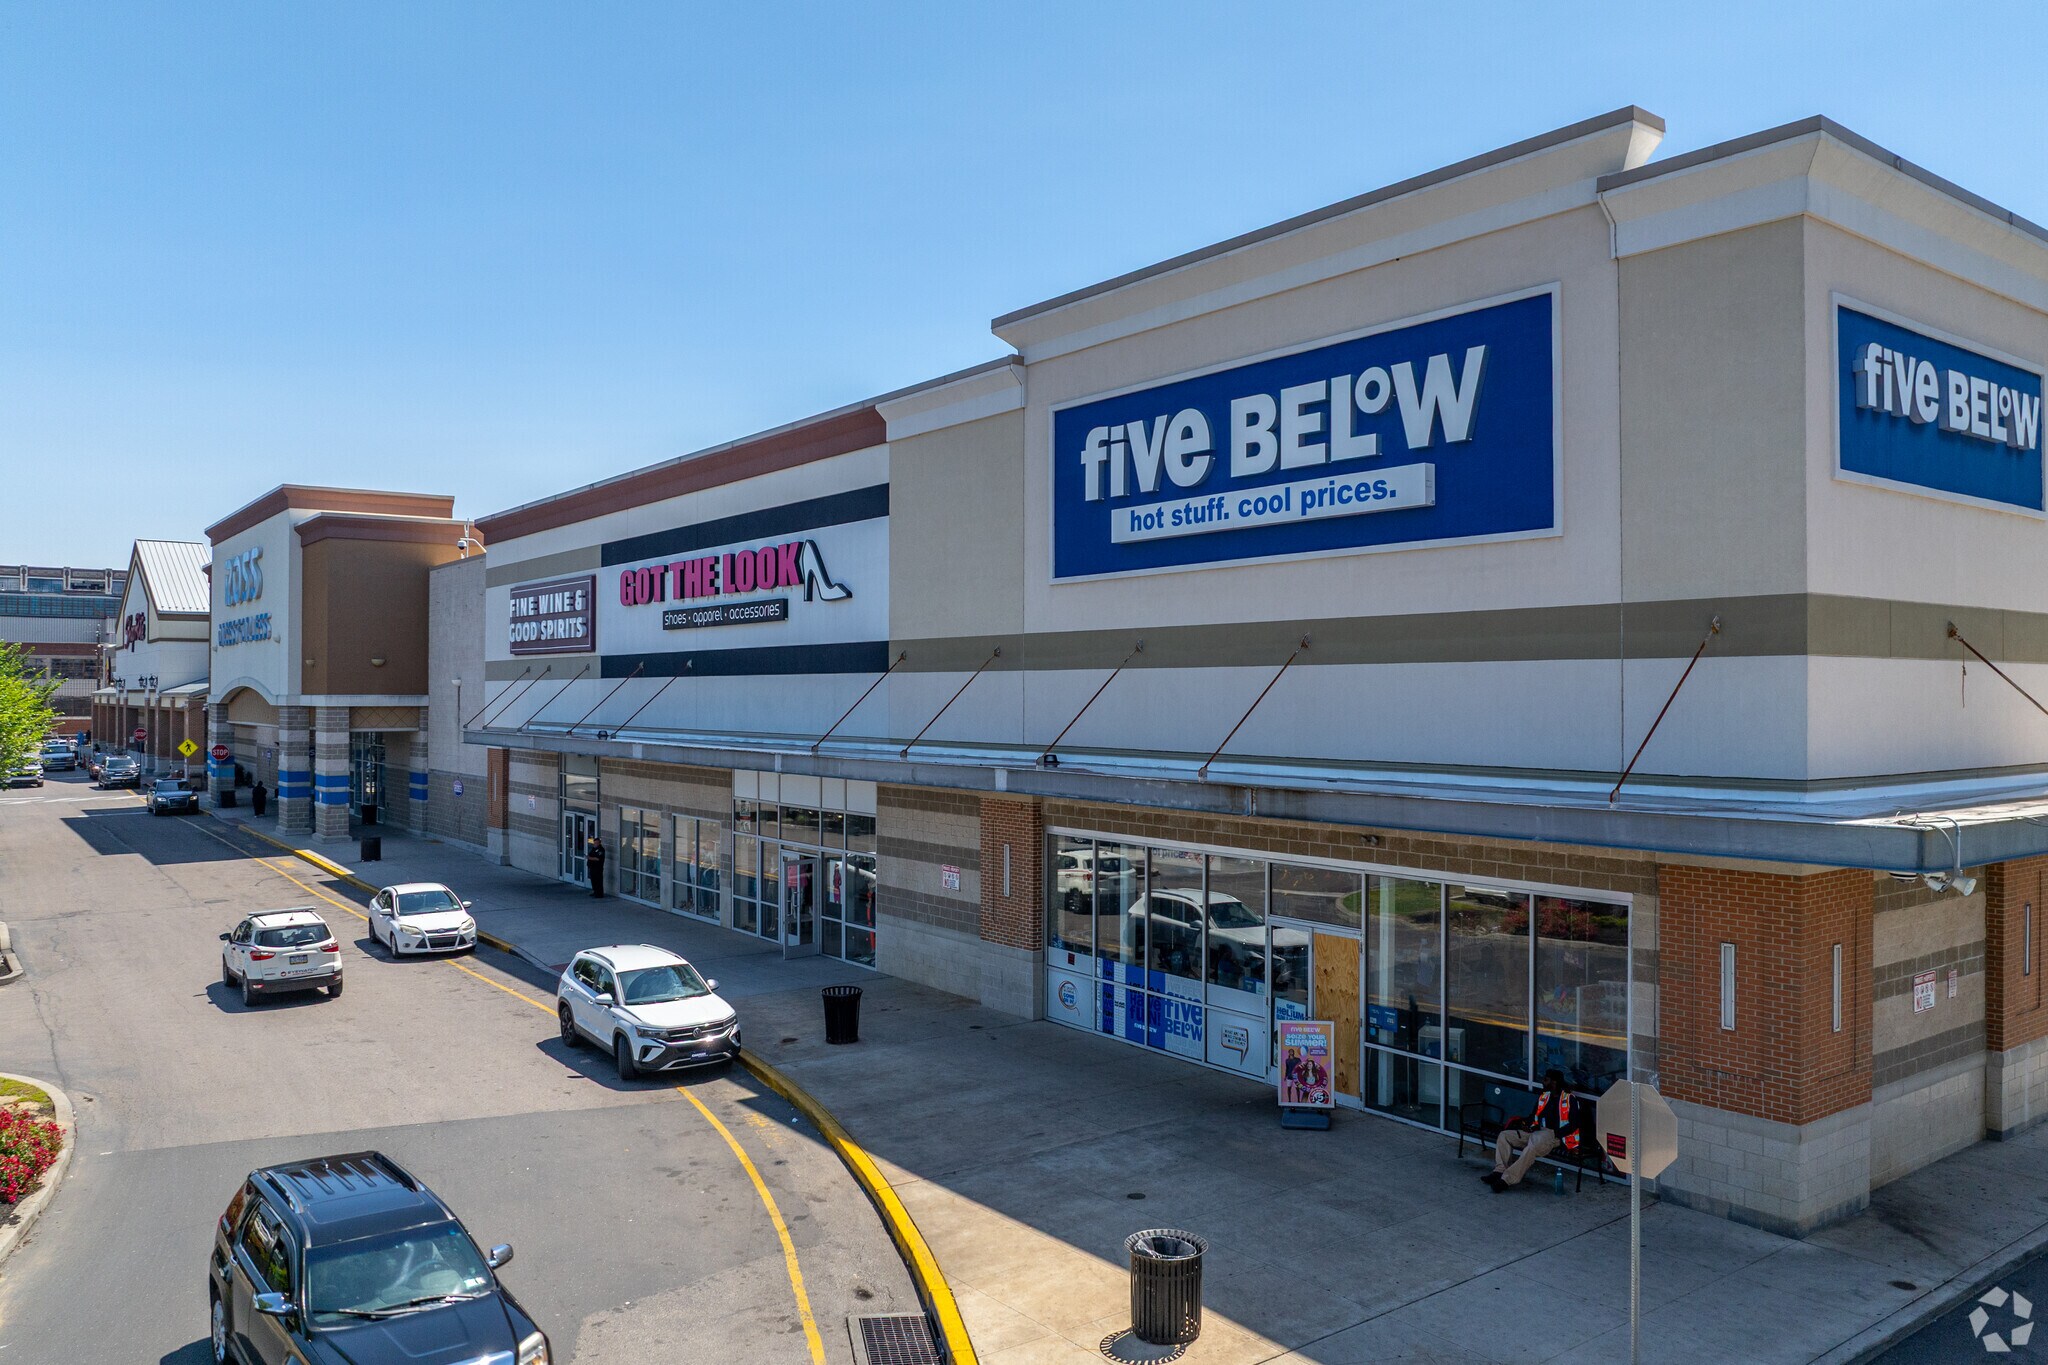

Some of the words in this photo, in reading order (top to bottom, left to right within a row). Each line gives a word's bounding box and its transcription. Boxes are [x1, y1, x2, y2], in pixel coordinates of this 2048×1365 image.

[1858, 342, 1939, 423] five
[1943, 368, 2040, 449] BELOW
[1081, 408, 1214, 501] five
[1230, 344, 1488, 478] BELOW
[1129, 508, 1165, 532] hot
[1171, 498, 1231, 527] stuff.
[1238, 486, 1292, 518] cool
[1300, 474, 1398, 515] prices.
[620, 565, 667, 606] GOT
[670, 555, 719, 600] THE
[722, 541, 804, 594] LOOK
[509, 596, 537, 618] FINE
[539, 591, 573, 614] WINE
[575, 589, 586, 611] &
[664, 610, 687, 626] shoes
[692, 607, 724, 626] apparel
[729, 602, 780, 620] accessories
[509, 621, 538, 643] GOOD
[541, 616, 586, 641] SPIRITS
[212, 747, 228, 756] STOP
